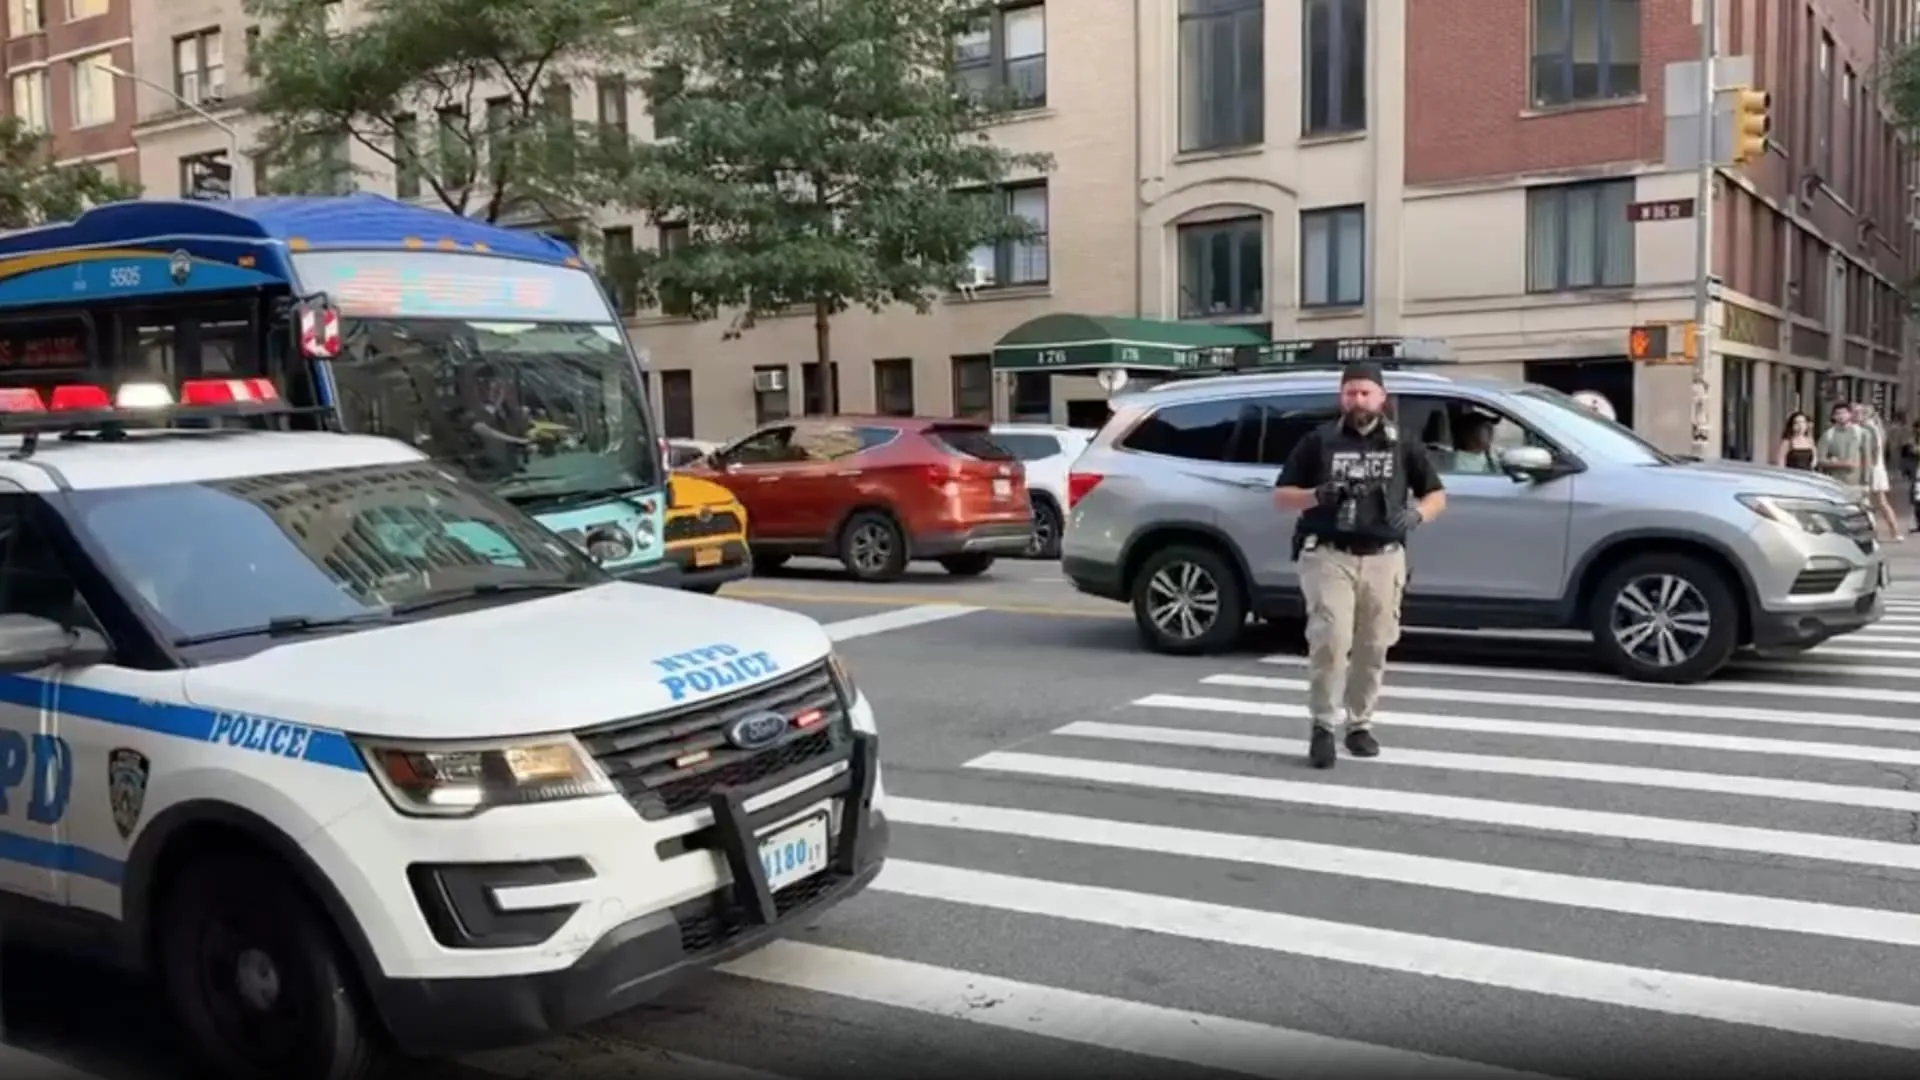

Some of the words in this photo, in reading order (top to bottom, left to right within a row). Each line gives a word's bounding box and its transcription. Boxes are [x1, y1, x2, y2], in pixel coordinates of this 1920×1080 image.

[1037, 349, 1066, 364] 176
[653, 643, 739, 671] NYPD
[659, 651, 780, 700] POLICE
[211, 712, 307, 757] POLICE
